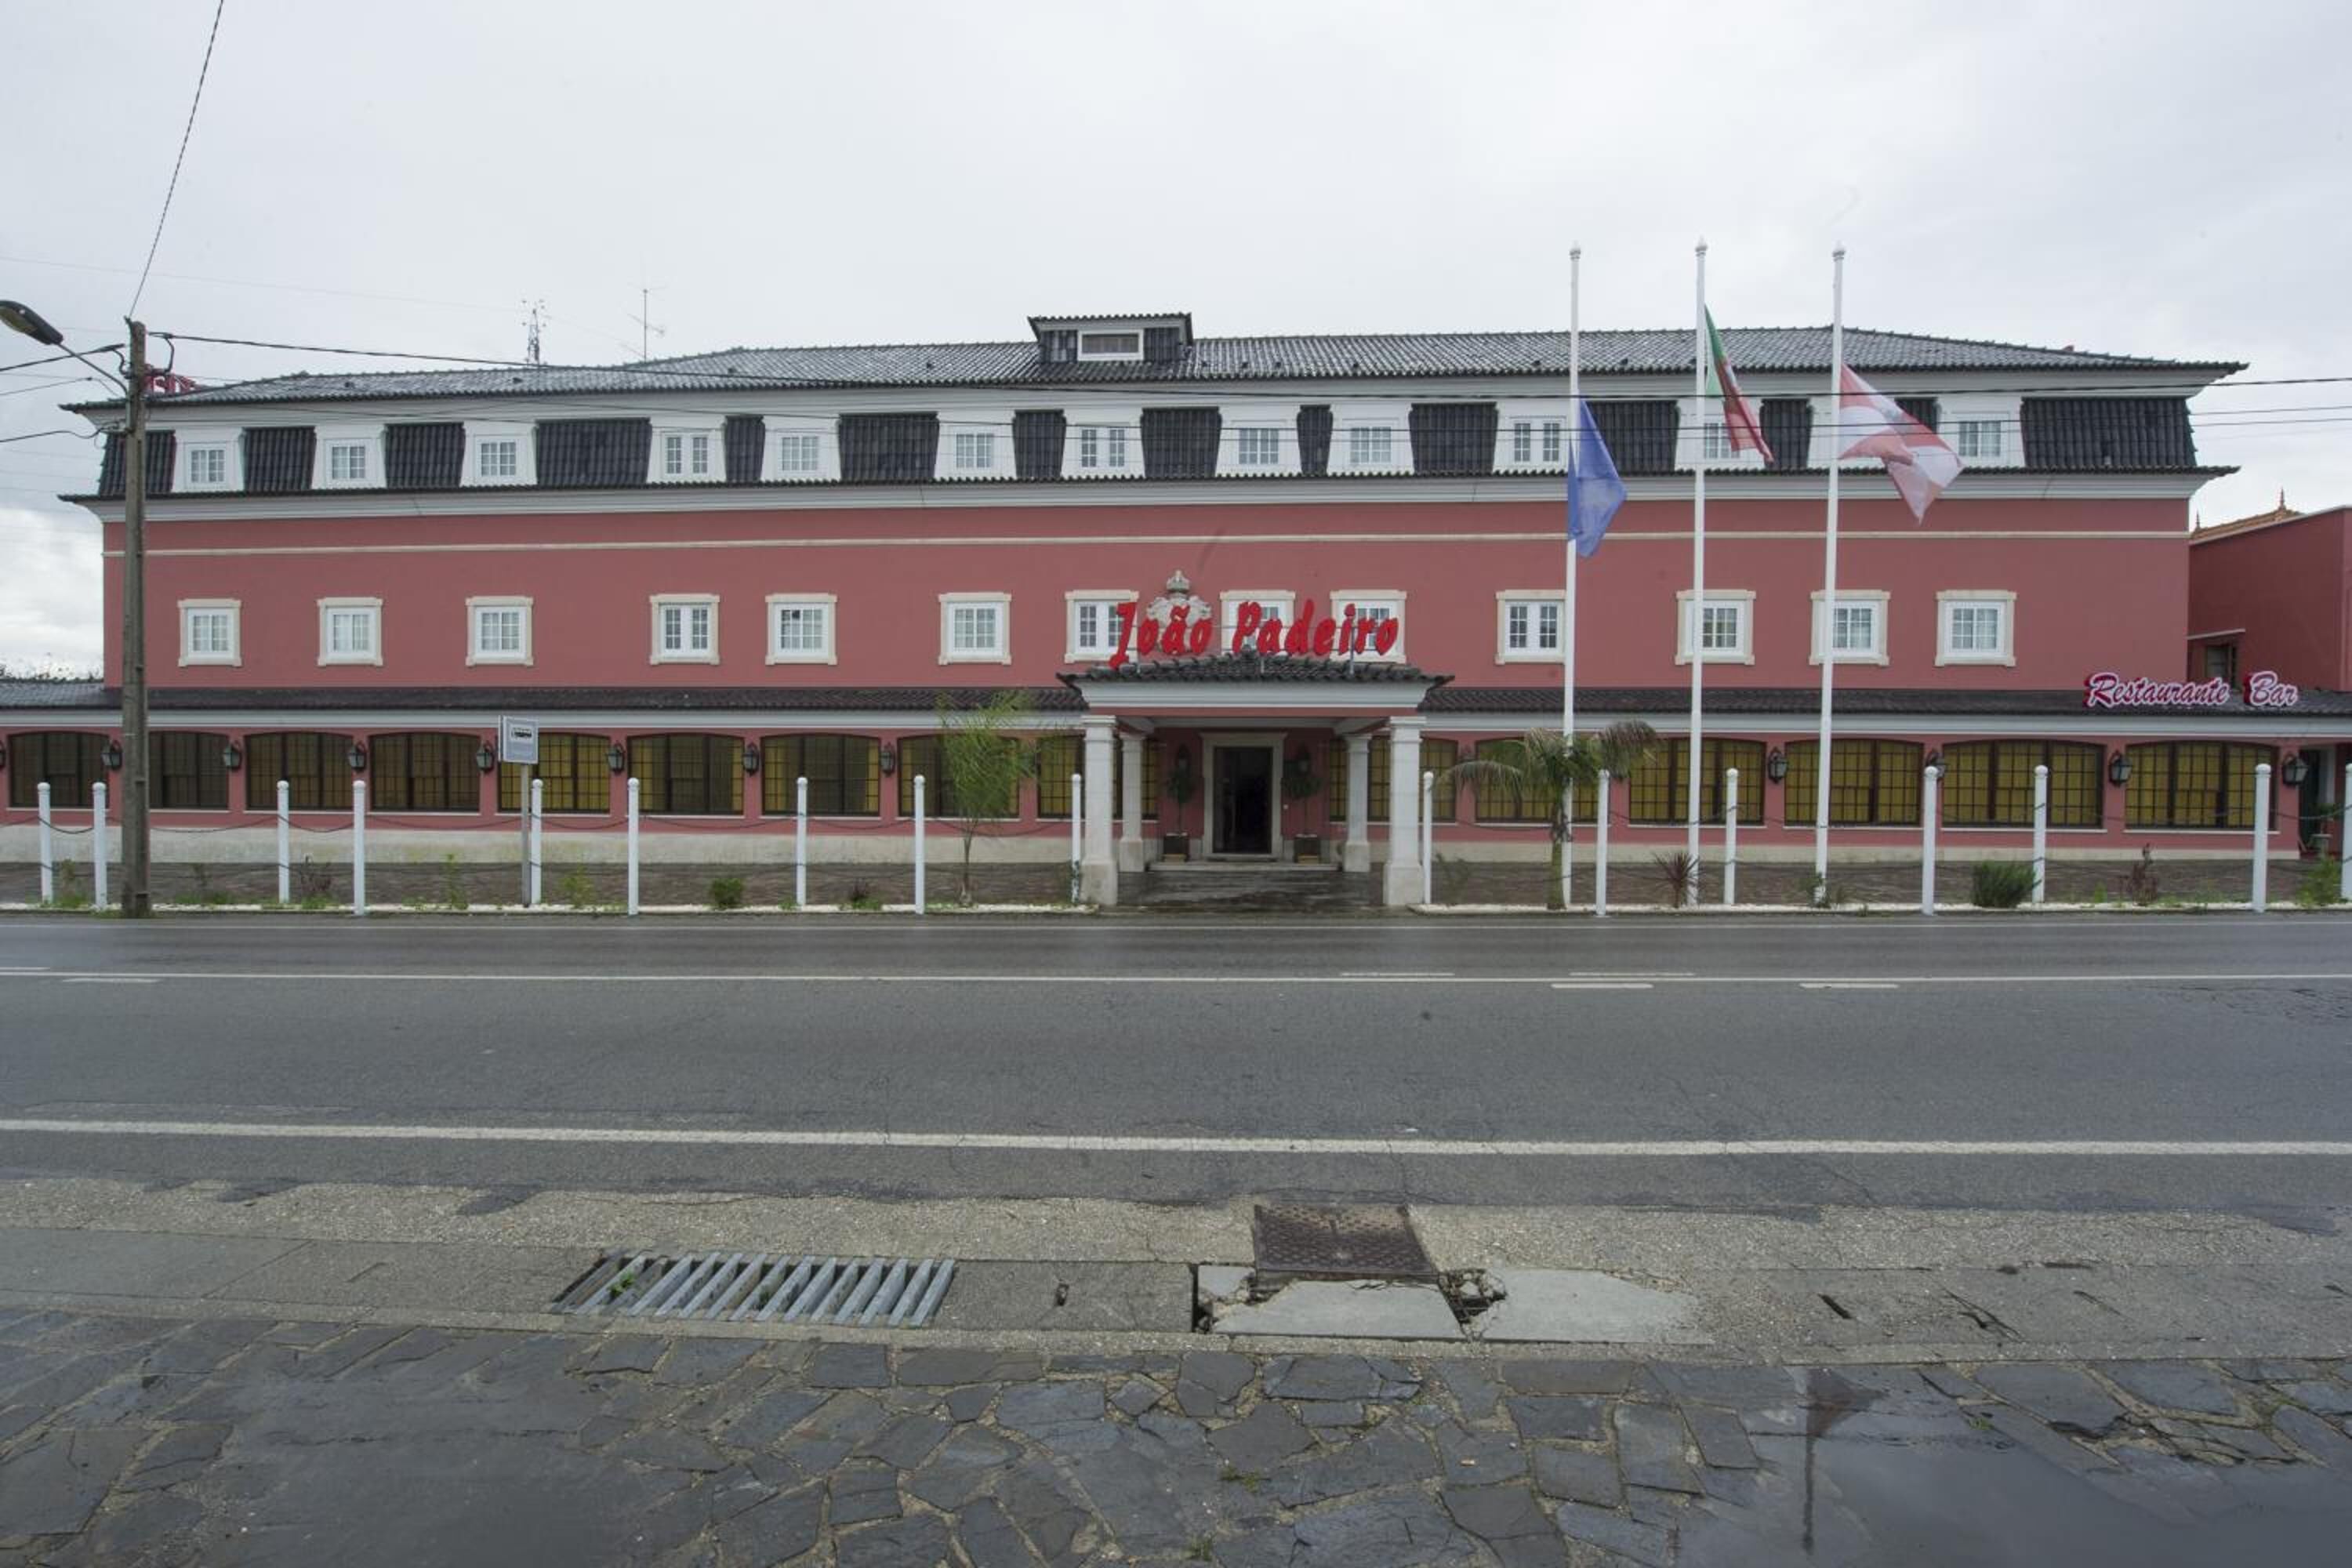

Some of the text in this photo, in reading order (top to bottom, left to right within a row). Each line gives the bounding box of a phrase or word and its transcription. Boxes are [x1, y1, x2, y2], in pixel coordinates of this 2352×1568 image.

[1108, 599, 1399, 670] João Padeiro
[2087, 670, 2298, 707] Restaurante Bar
